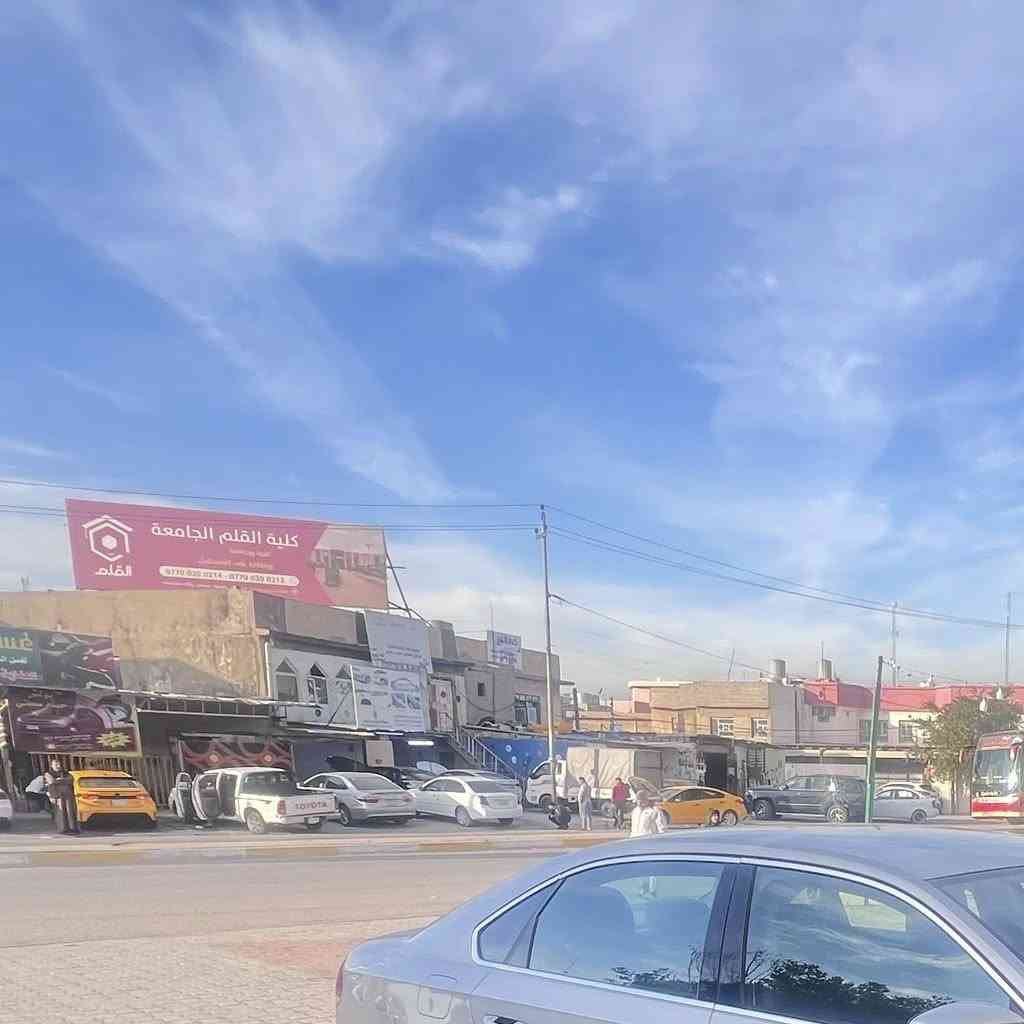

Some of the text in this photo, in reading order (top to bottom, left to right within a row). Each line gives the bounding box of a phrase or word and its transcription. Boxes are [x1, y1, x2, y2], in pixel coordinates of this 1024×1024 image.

[151, 521, 299, 550] كلية القلم الجامعة
[95, 563, 132, 577] القلم
[295, 801, 328, 809] TOYOTA
